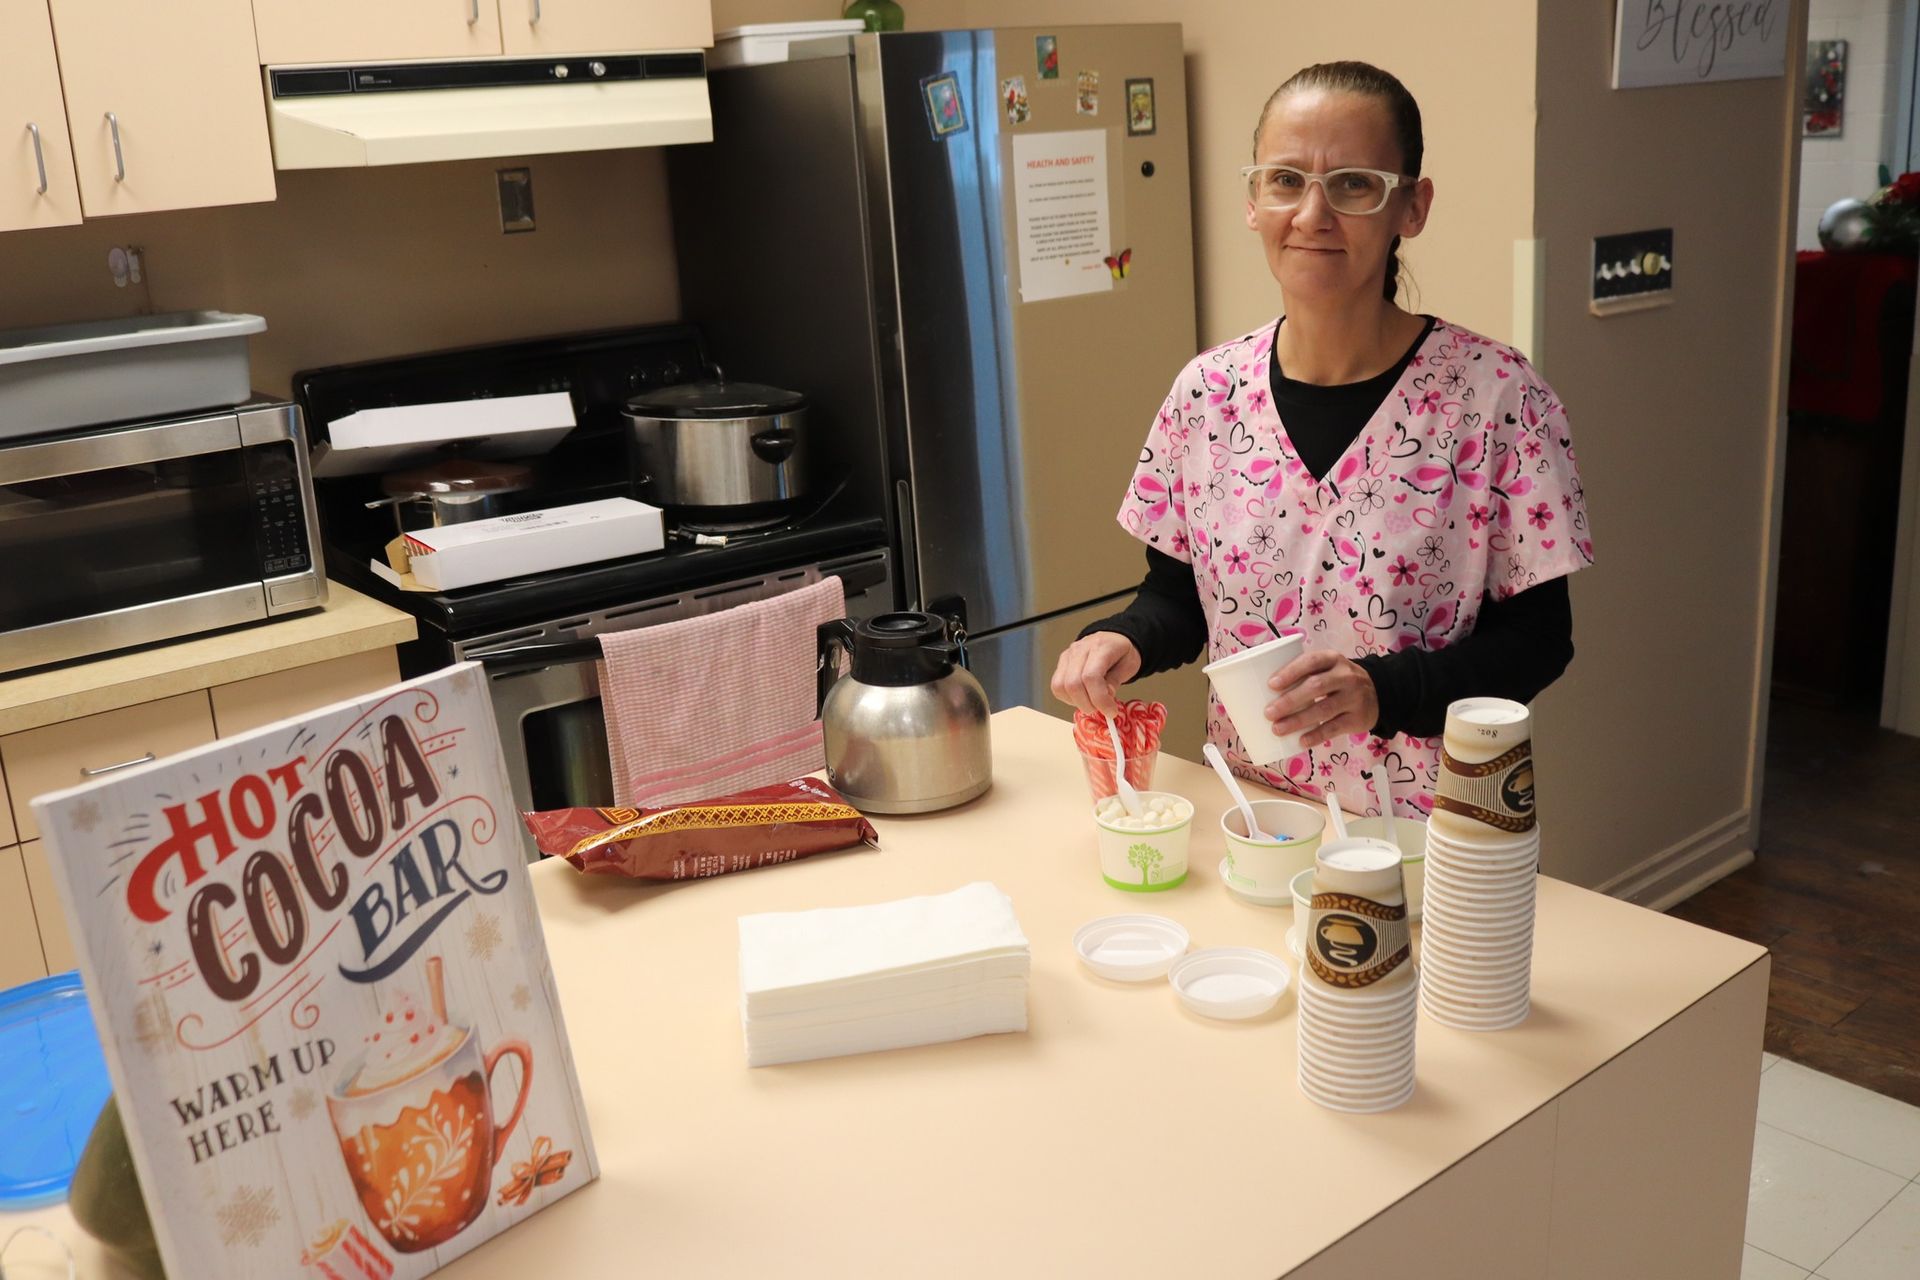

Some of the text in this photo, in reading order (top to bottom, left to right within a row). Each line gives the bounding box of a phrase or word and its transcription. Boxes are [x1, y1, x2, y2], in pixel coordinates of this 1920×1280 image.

[1027, 156, 1094, 169] HEALTH AND SAFETY
[126, 755, 307, 923] HOT
[187, 714, 441, 1001] COCOA
[347, 818, 508, 961] BAR
[170, 1038, 336, 1126] WARM UP
[188, 1101, 281, 1165] HERE
